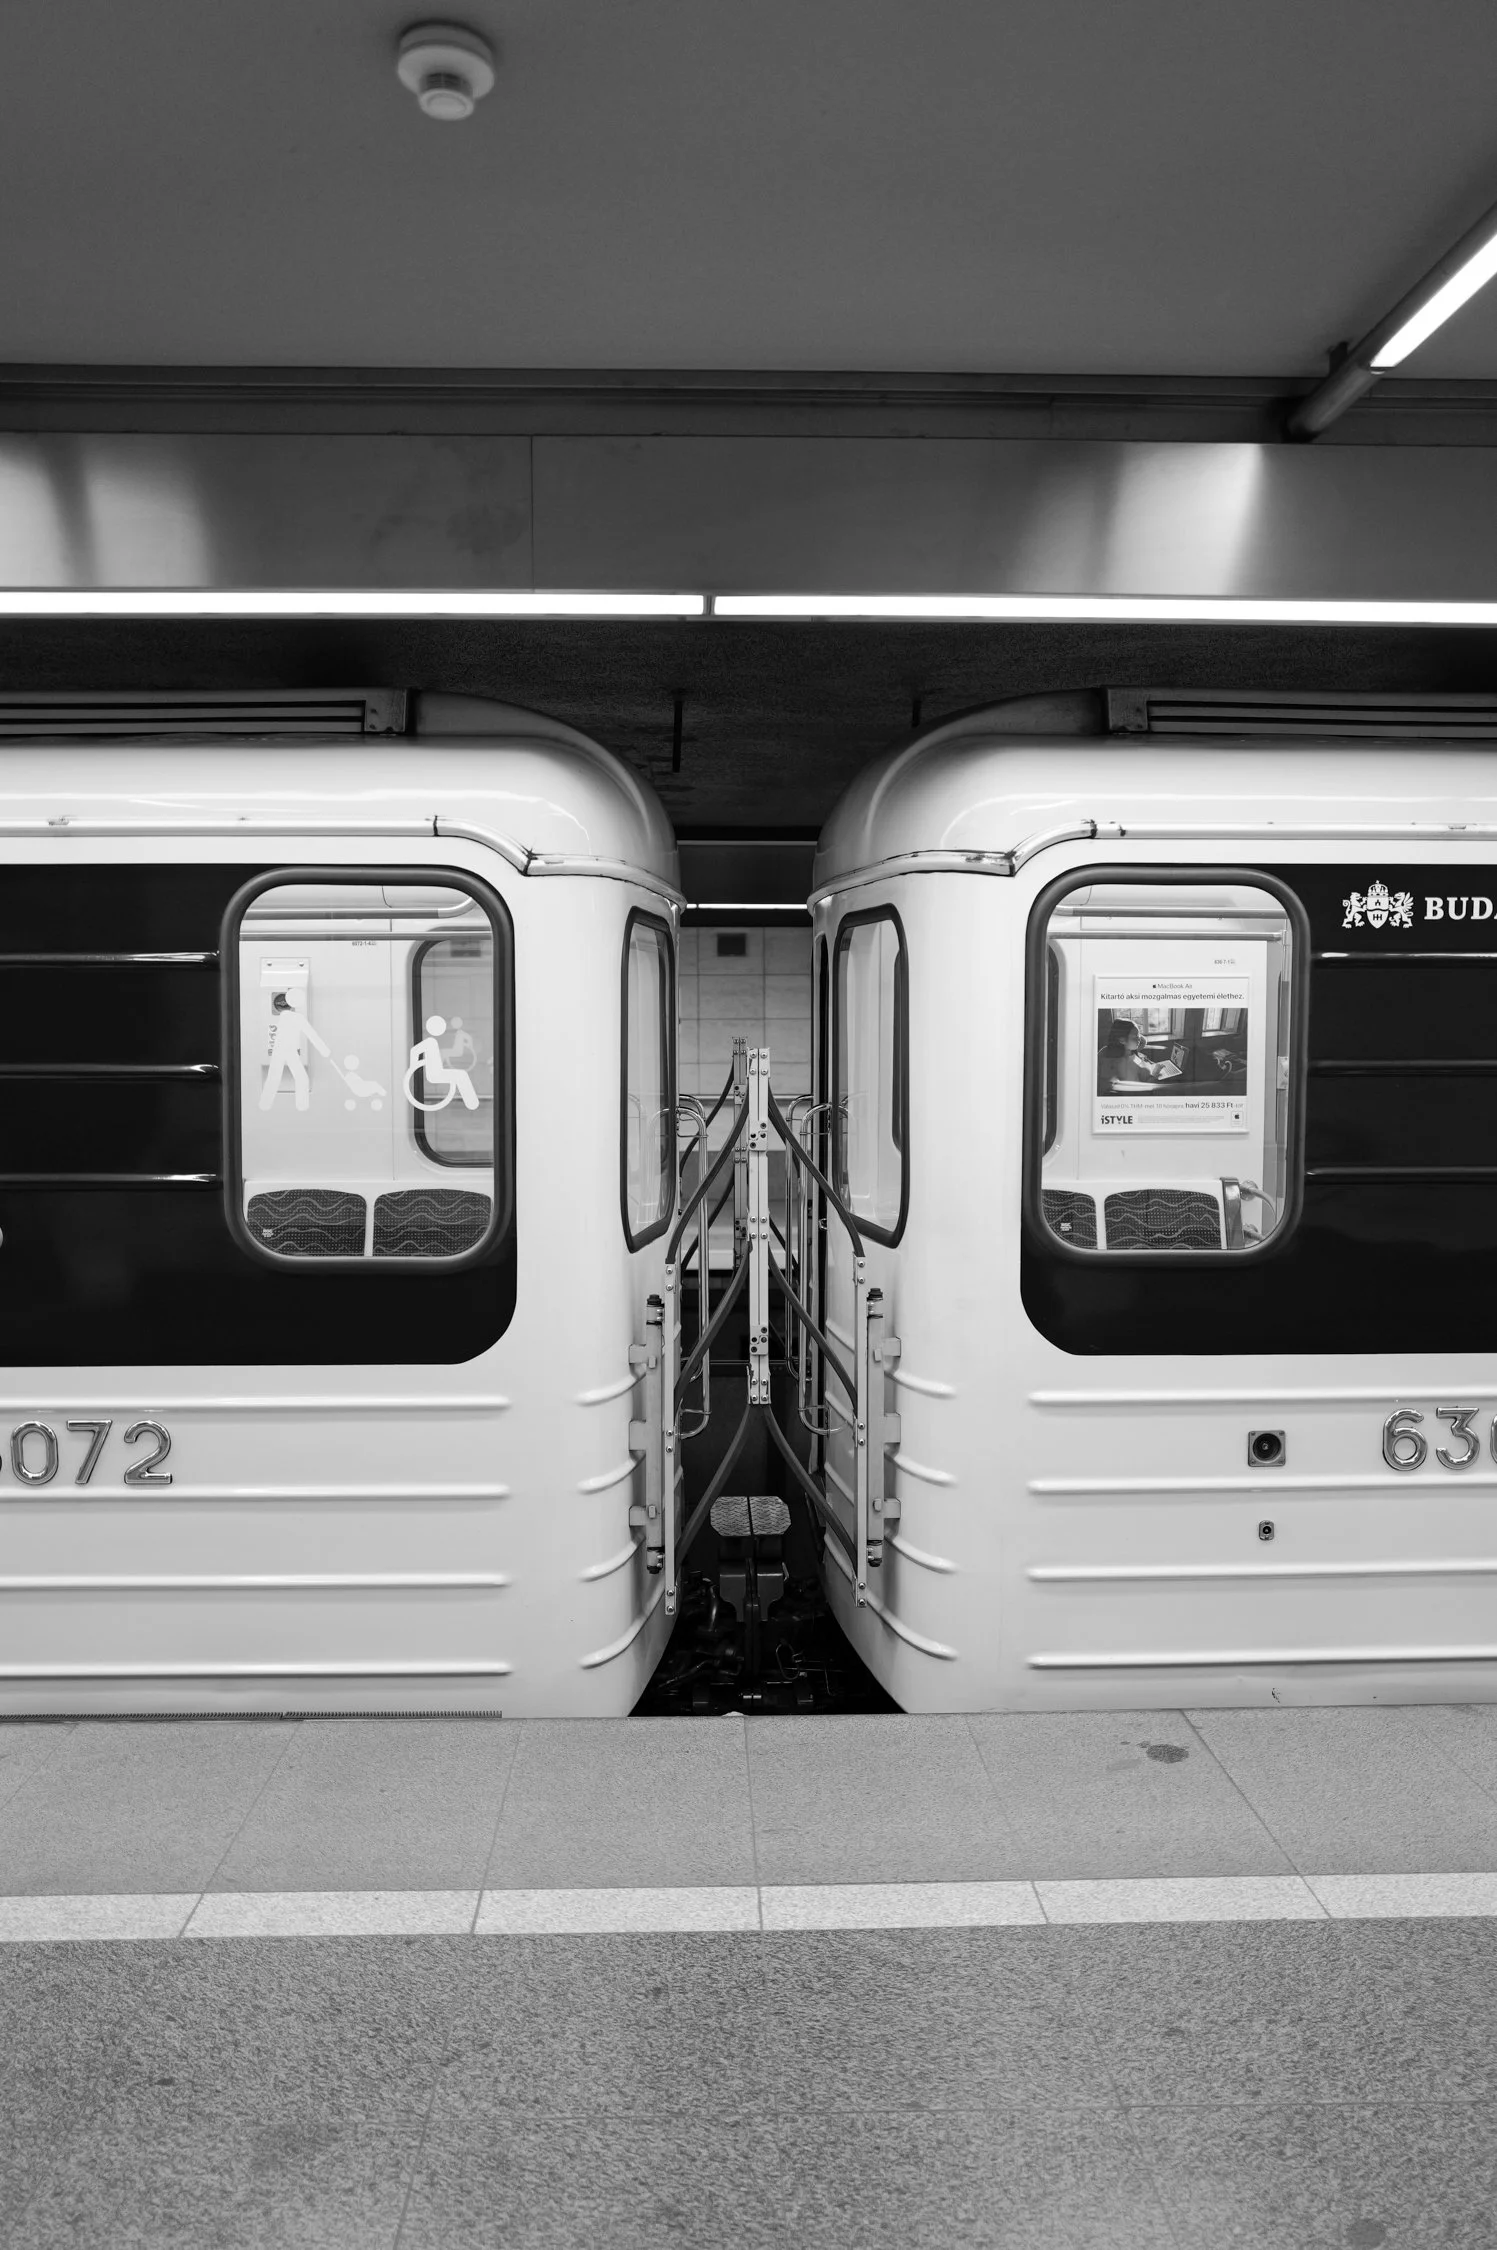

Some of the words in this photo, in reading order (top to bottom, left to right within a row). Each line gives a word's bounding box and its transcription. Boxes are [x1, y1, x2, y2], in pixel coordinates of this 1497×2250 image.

[1424, 897, 1497, 920] BUD
[1141, 993, 1182, 1001] mozgalmas
[1182, 993, 1216, 1001] egyetemi
[1216, 992, 1245, 1000] élethez.
[1101, 1115, 1134, 1125] iSTYLE
[1383, 1407, 1497, 1472] 63
[0, 1419, 173, 1486] 072
